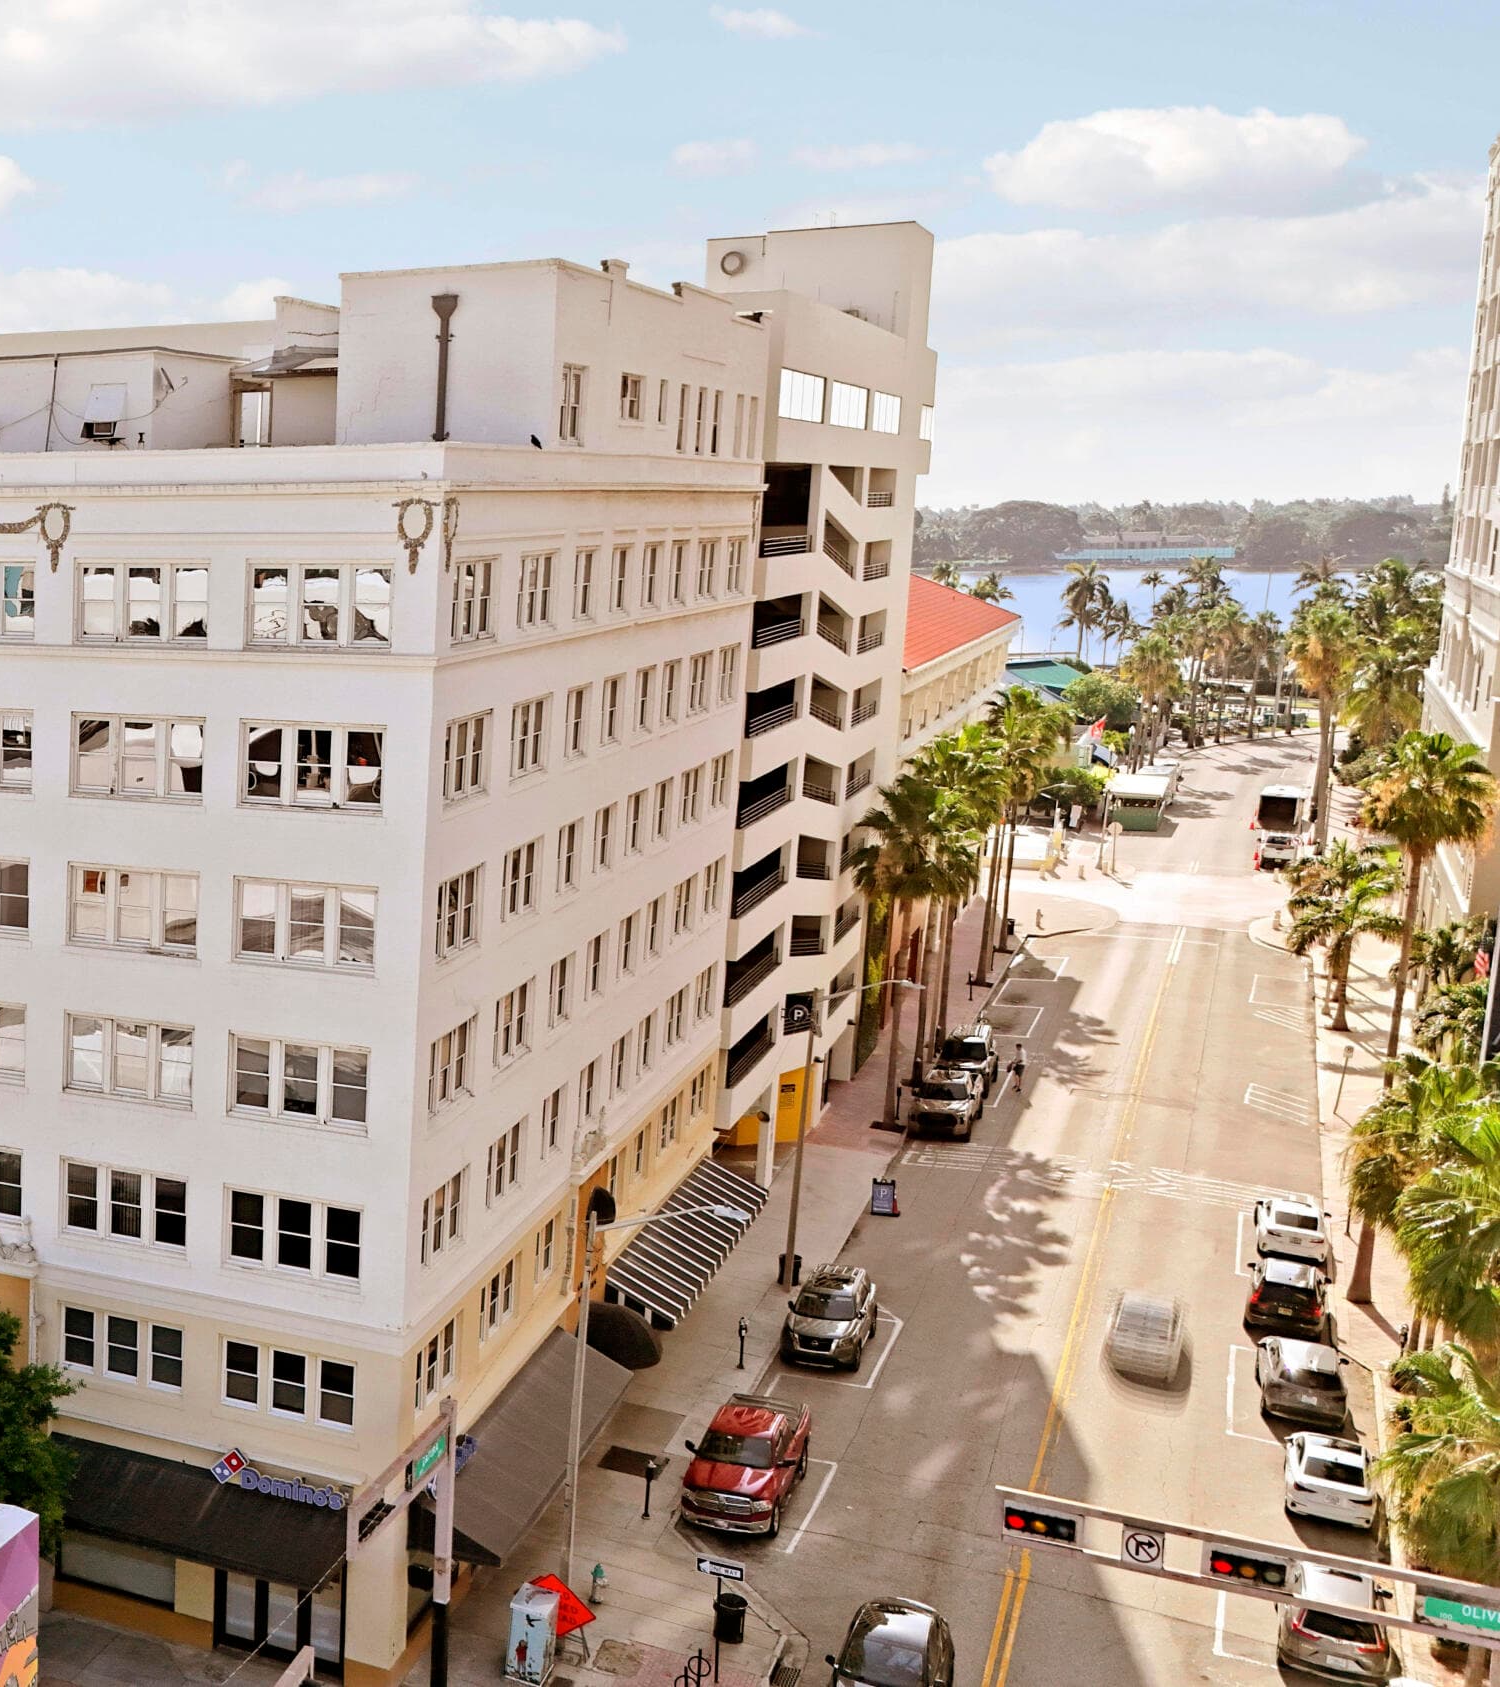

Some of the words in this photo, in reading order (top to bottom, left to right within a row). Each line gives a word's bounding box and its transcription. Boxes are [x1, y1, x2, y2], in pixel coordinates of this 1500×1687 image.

[794, 1010, 804, 1021] P
[881, 1189, 888, 1198] P
[240, 1467, 346, 1511] Domino's
[724, 1568, 739, 1577] WAY
